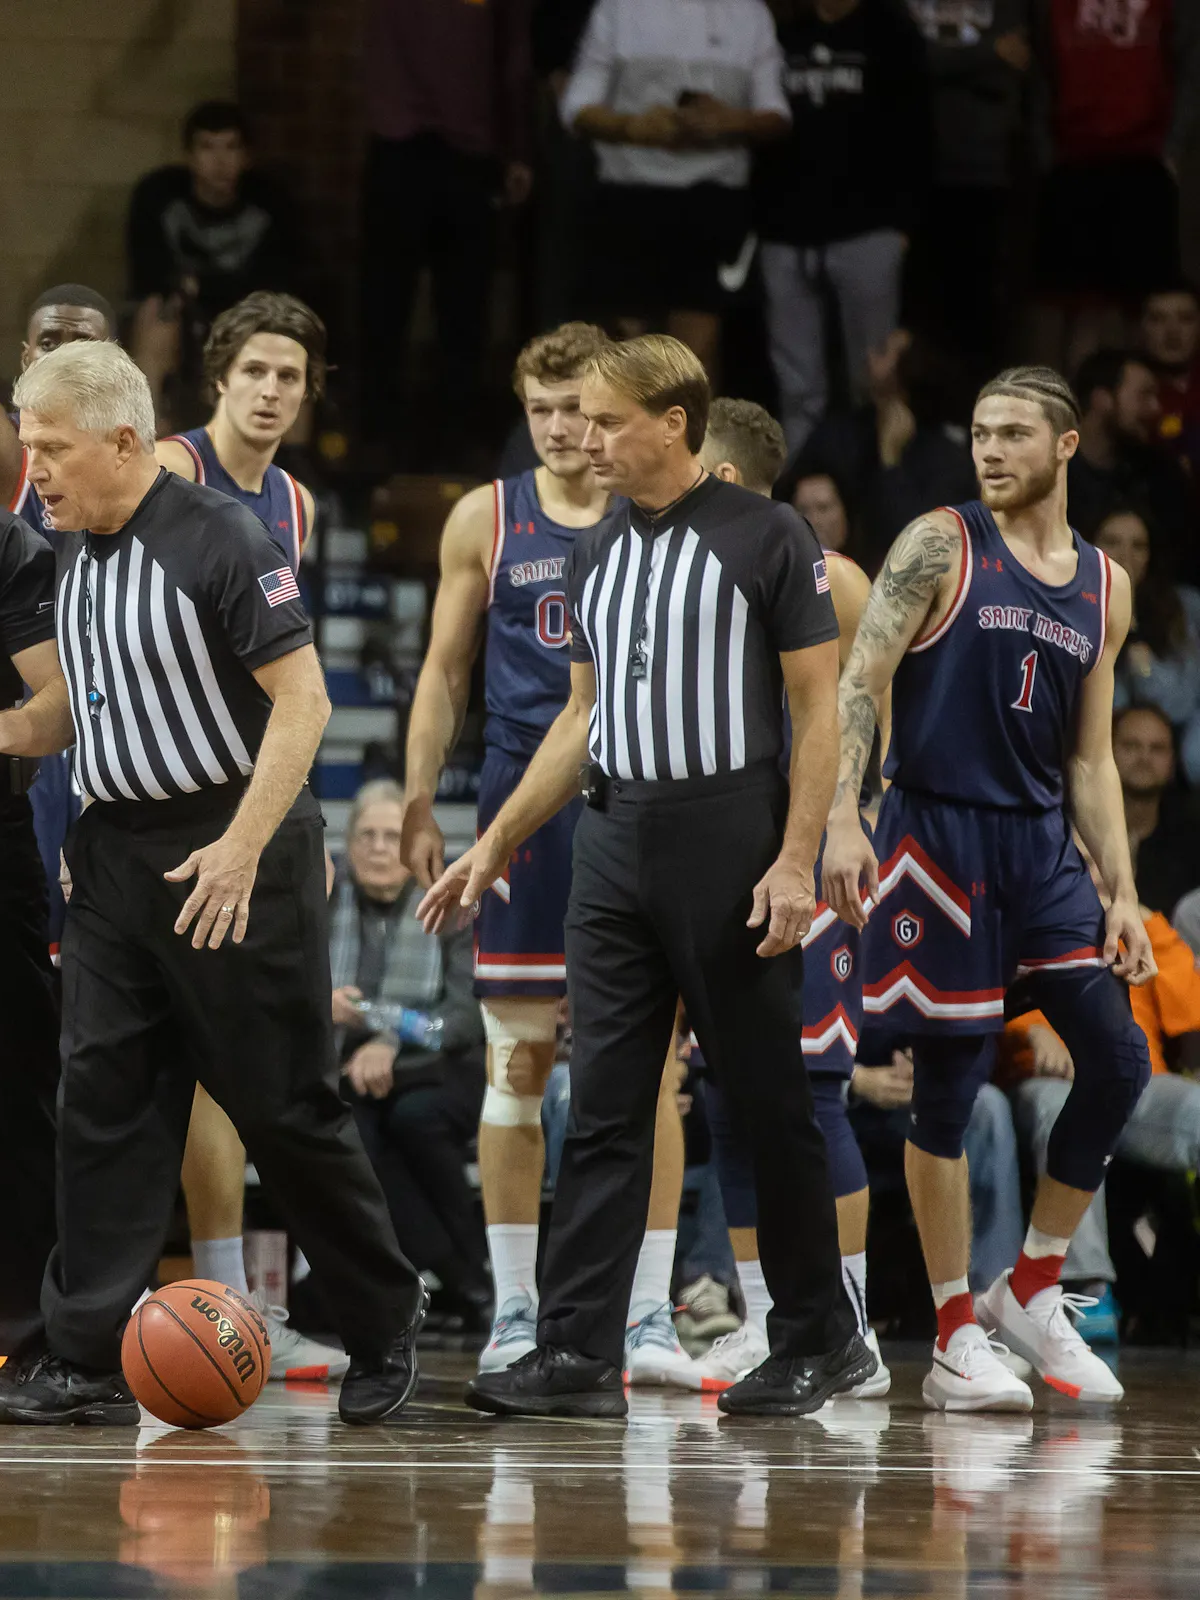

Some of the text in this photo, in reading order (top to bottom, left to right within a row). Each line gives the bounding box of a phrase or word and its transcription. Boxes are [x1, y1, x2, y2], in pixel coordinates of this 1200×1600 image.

[535, 590, 570, 649] 0
[978, 605, 1094, 665] SAINT MARY'S
[1010, 649, 1039, 713] 1
[900, 920, 912, 940] G
[839, 955, 848, 975] G
[190, 1292, 257, 1385] Wilson
